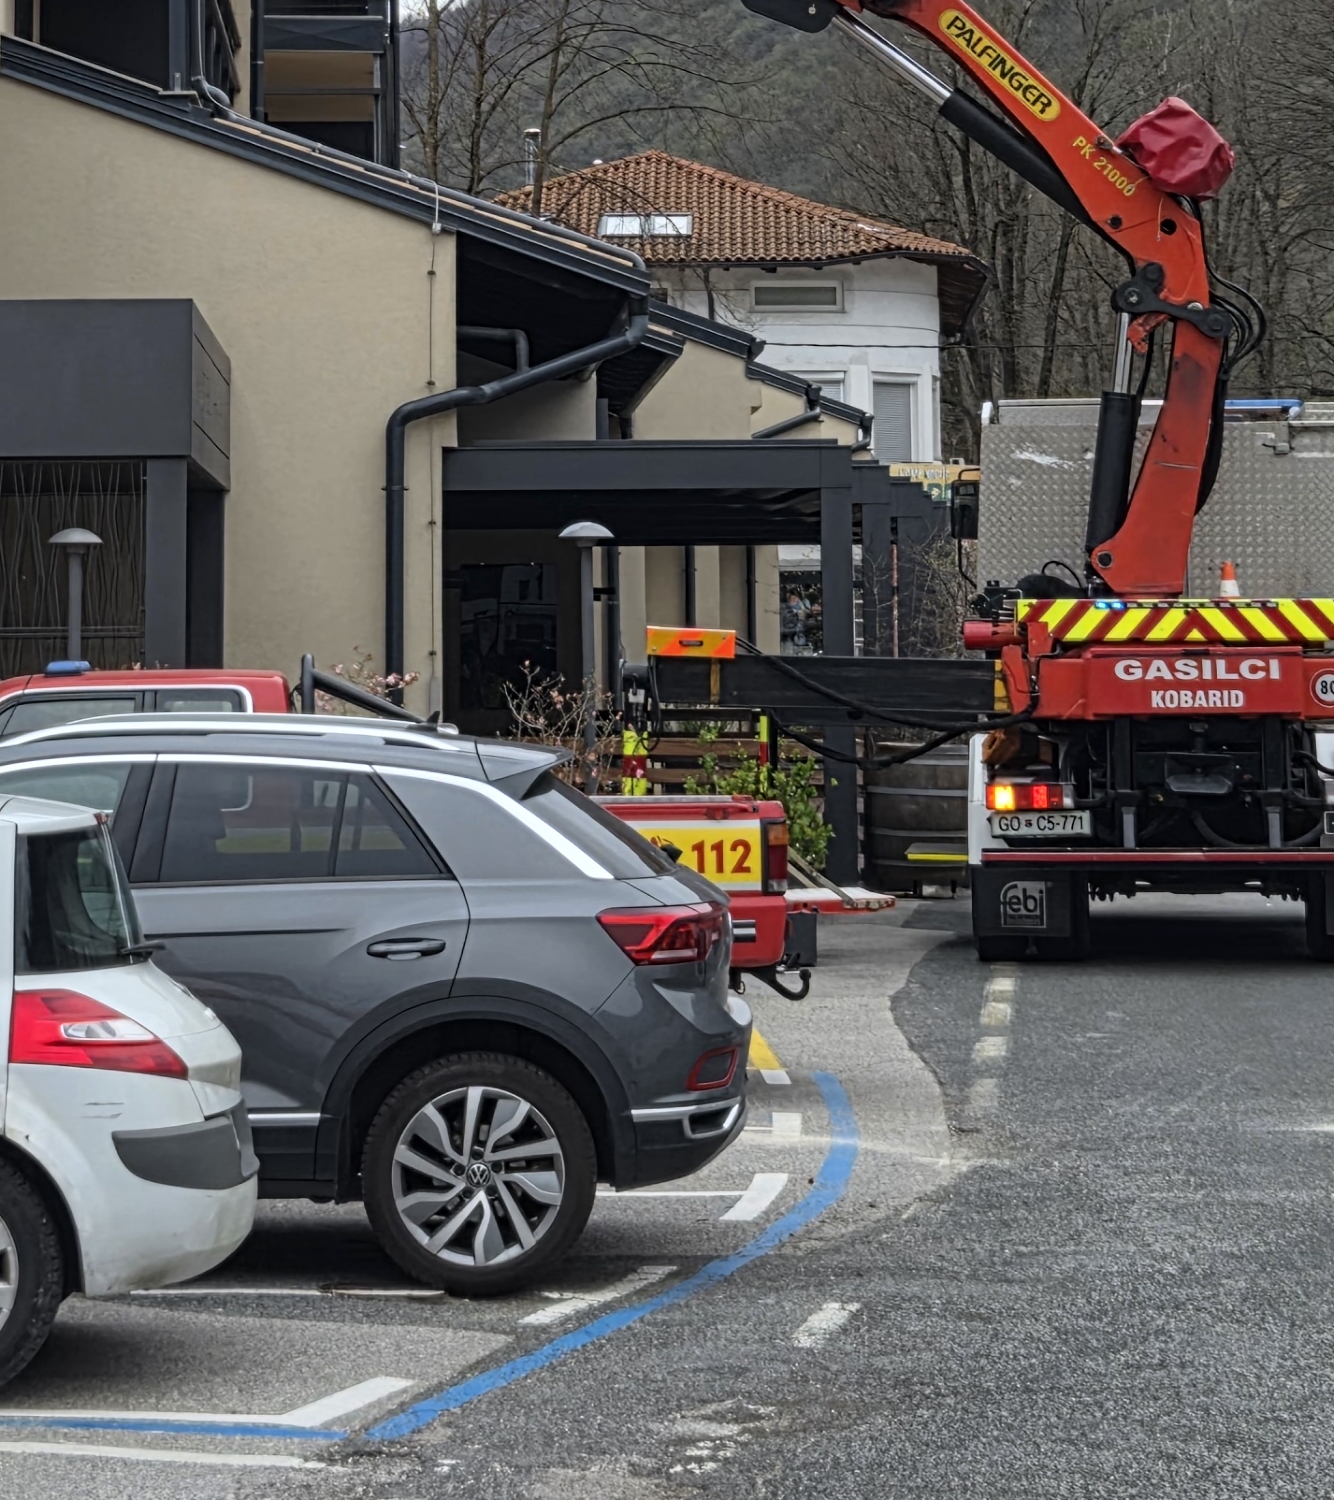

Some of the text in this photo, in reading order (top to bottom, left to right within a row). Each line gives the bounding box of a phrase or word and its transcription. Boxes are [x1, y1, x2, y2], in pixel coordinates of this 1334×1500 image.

[947, 15, 1052, 115] PALFINGER
[1072, 136, 1136, 197] PK 21000
[1114, 658, 1280, 680] GASILCI
[1151, 690, 1244, 708] KOBARID
[998, 815, 1083, 832] GO C5-771
[691, 838, 751, 874] 112
